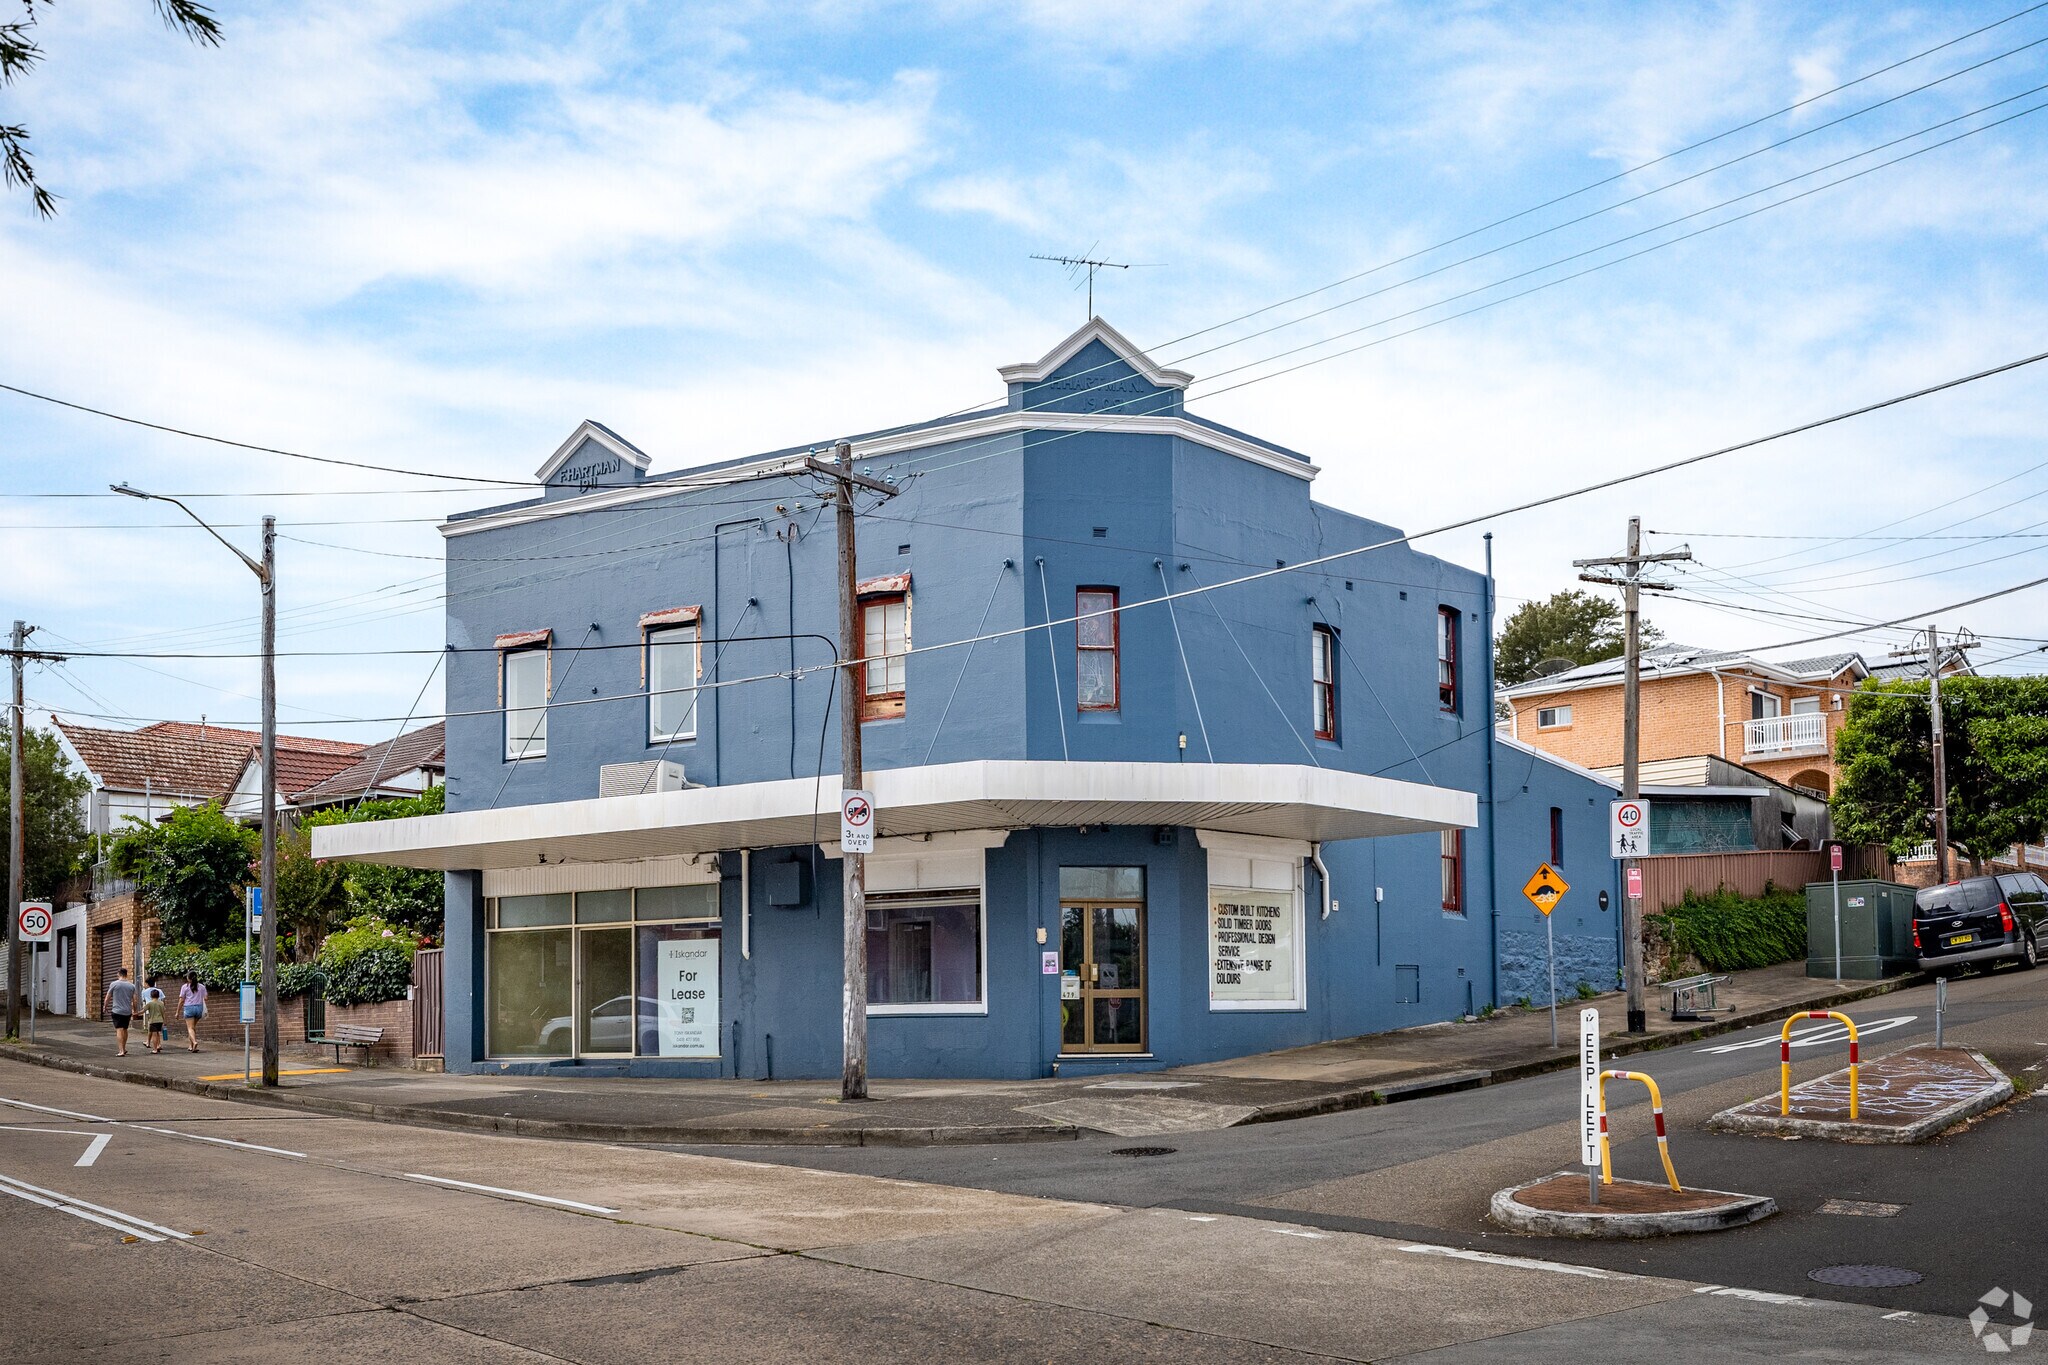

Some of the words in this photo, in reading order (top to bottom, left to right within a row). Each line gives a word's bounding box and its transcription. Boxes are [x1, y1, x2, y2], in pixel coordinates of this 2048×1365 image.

[1622, 810, 1638, 821] 40
[1218, 903, 1239, 916] CUSTOM
[1240, 905, 1254, 916] BUILT
[1256, 906, 1280, 918] KITCHENS
[26, 915, 46, 929] 50
[1217, 918, 1232, 929] SOLID
[1234, 918, 1253, 930] TIMBER
[1255, 919, 1272, 931] DOORS
[1218, 932, 1256, 944] PROFESSIONAL
[1258, 933, 1275, 944] DESIGN
[675, 950, 707, 958] Iskandar
[1218, 946, 1240, 957] SERVICE
[1265, 960, 1272, 971] OF
[679, 970, 697, 982] For
[1216, 973, 1241, 984] COLOURS
[672, 988, 705, 1000] Lease
[1586, 1094, 1596, 1162] LEFT
